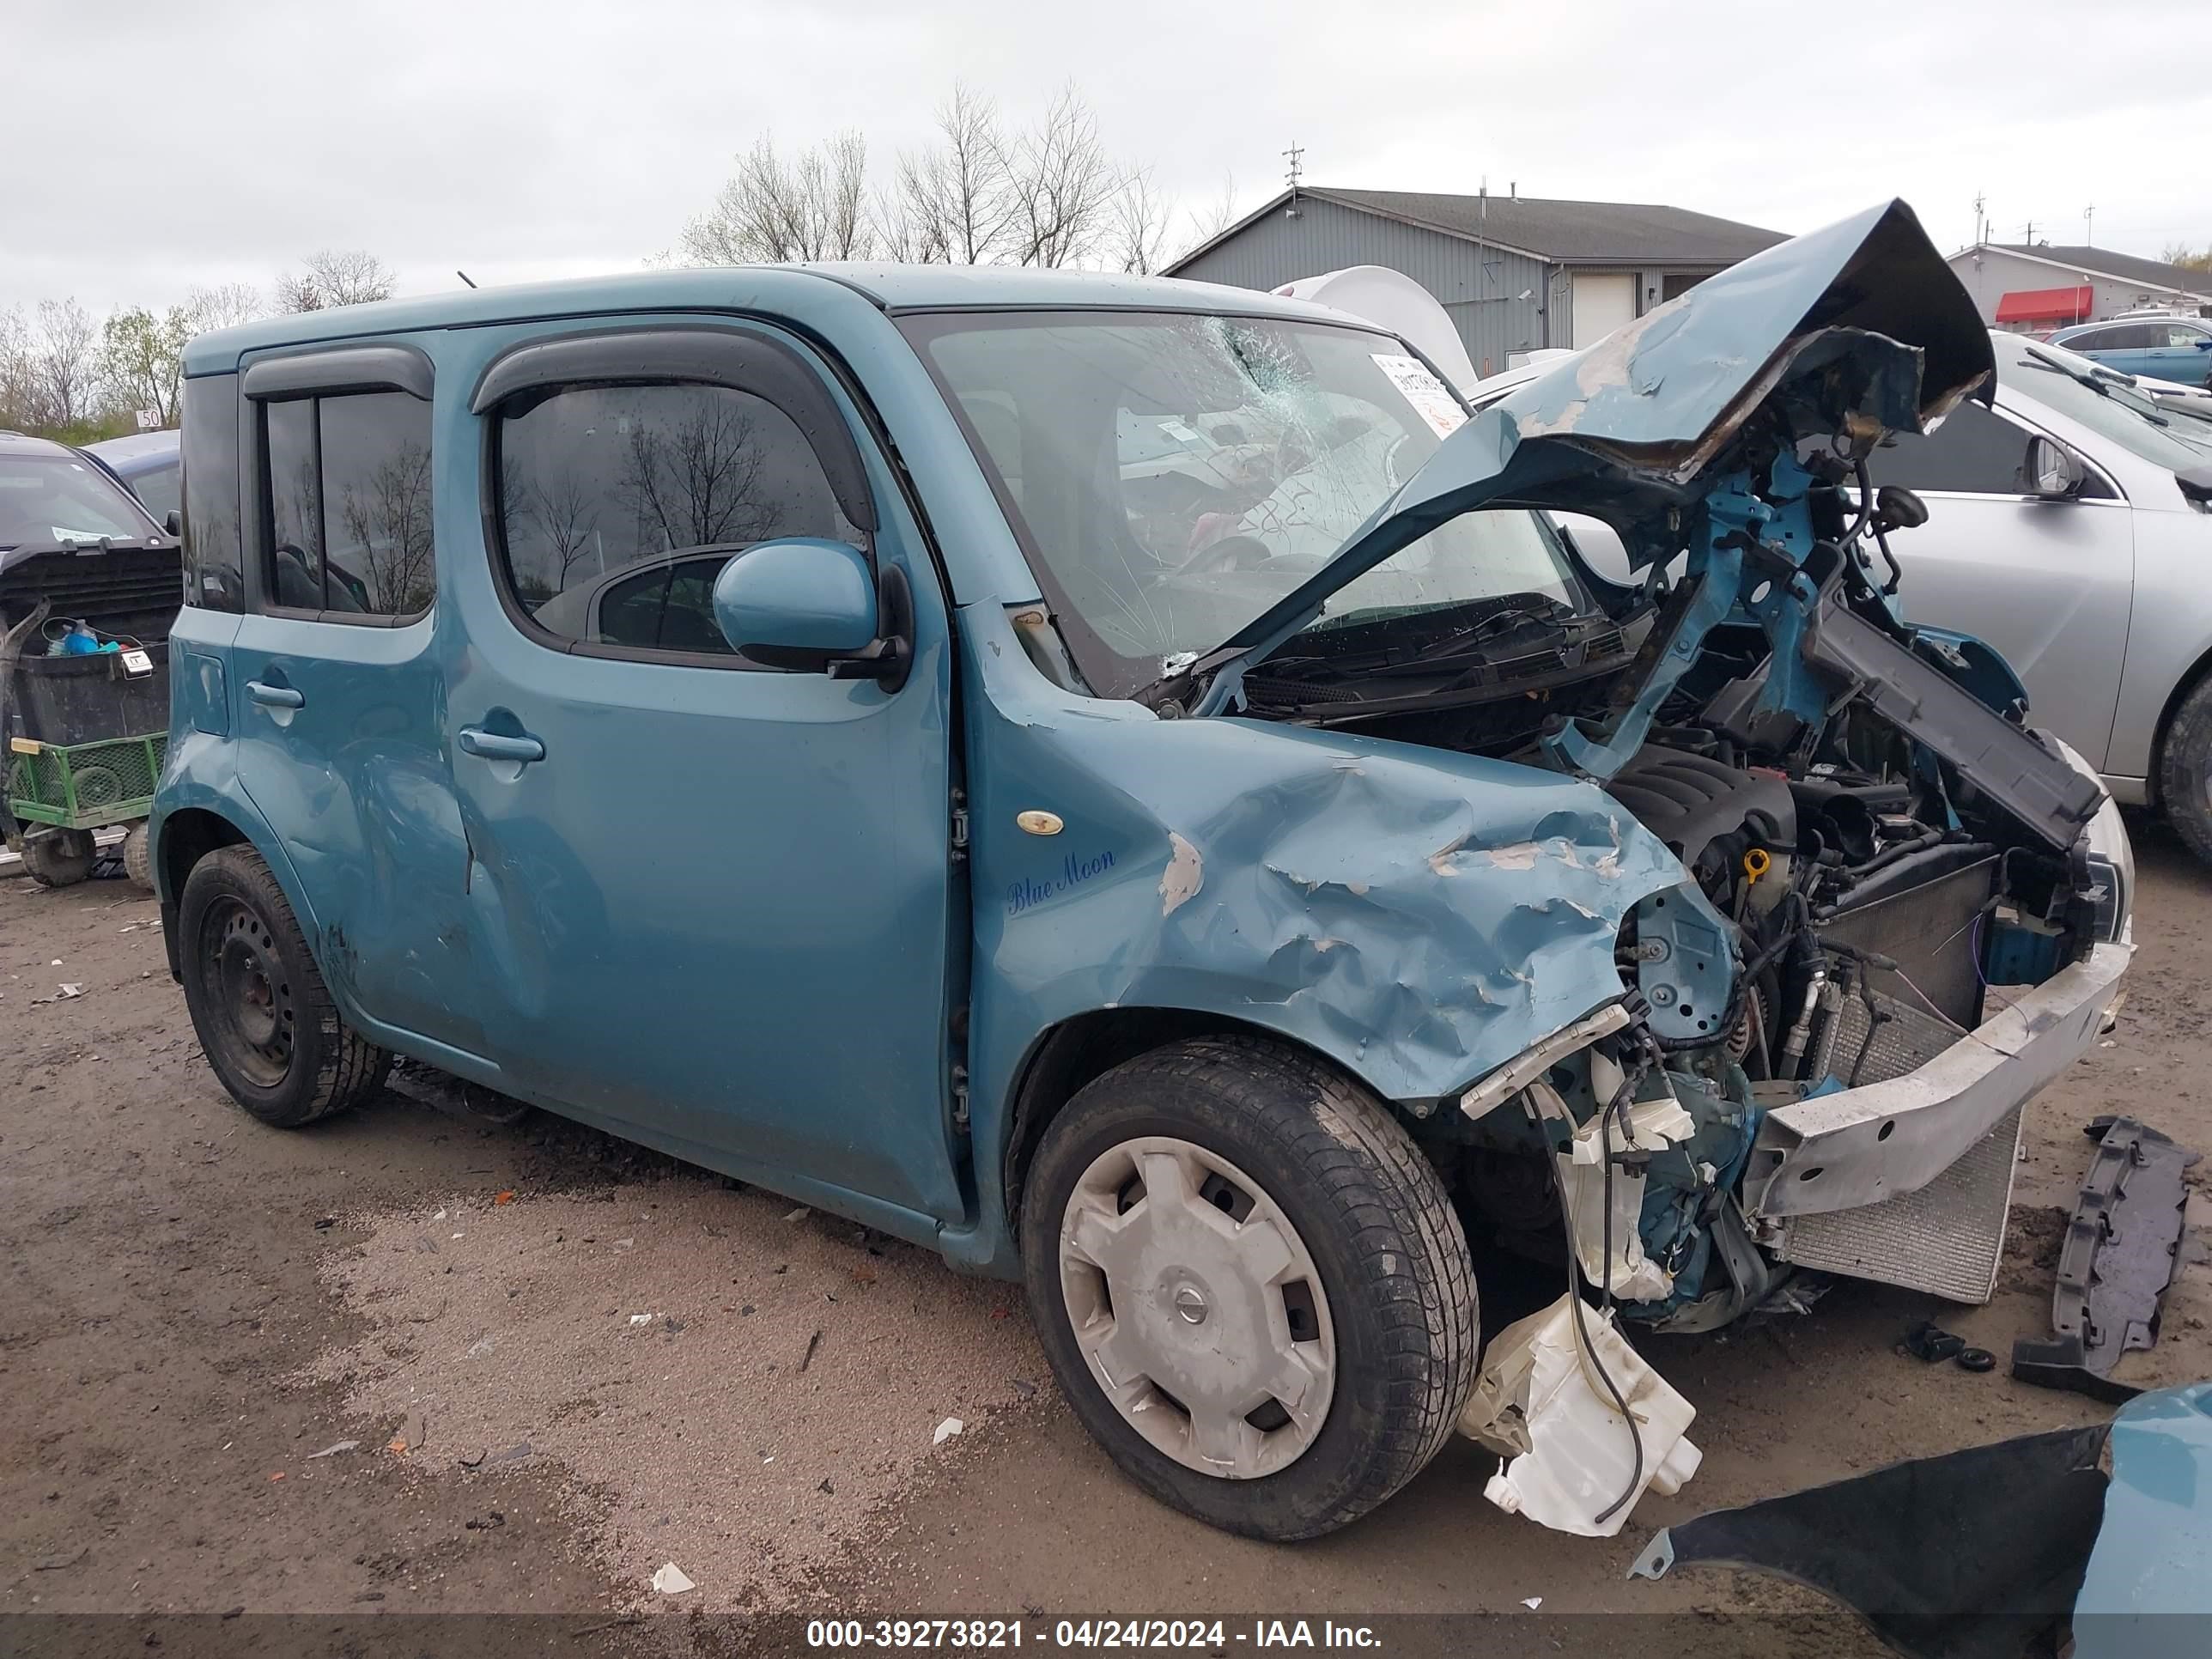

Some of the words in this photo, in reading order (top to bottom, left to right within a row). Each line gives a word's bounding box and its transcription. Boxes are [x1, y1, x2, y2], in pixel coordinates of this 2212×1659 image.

[143, 410, 160, 426] 50
[1007, 877, 1053, 915] Blue
[1057, 851, 1116, 890] Moon
